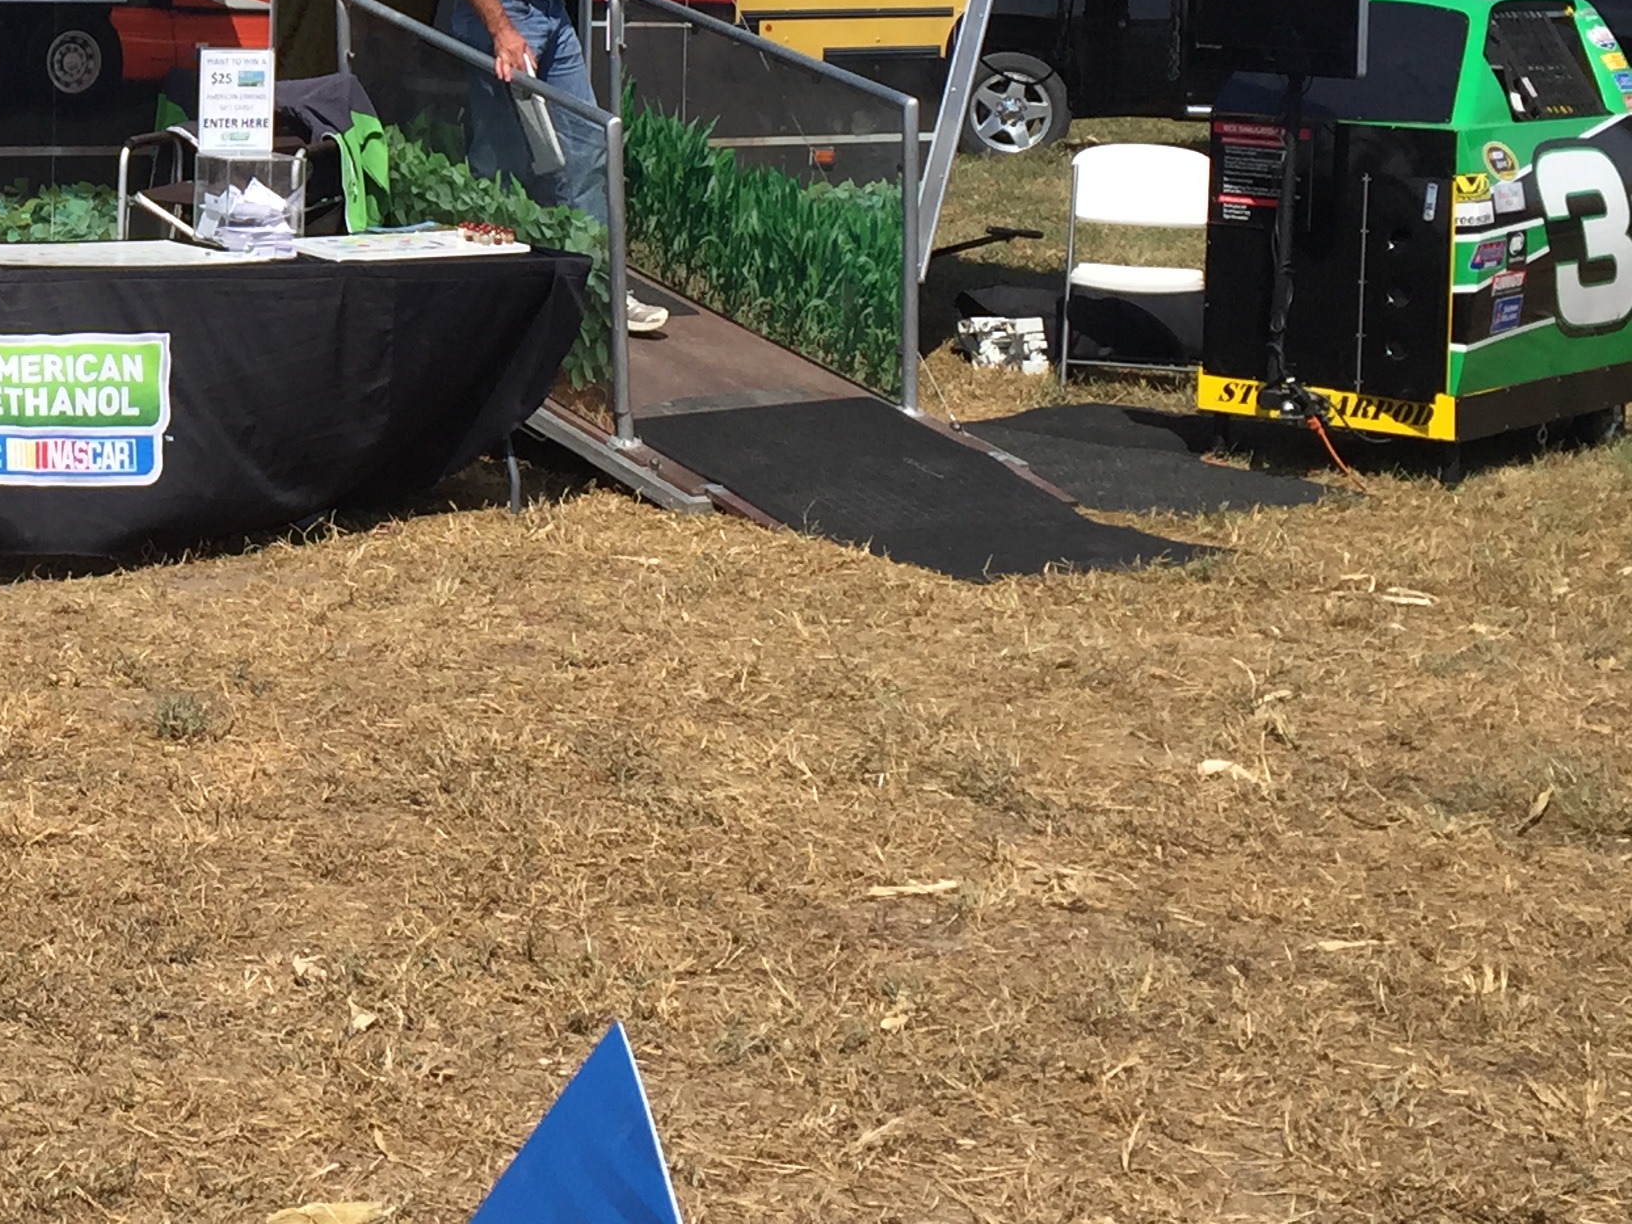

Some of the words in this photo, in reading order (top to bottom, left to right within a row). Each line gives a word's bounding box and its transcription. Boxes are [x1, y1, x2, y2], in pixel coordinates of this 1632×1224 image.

[210, 71, 233, 86] $25
[203, 117, 238, 128] ENTER
[241, 117, 269, 128] HERE
[1535, 149, 1632, 326] 3
[48, 439, 135, 471] NASCAR
